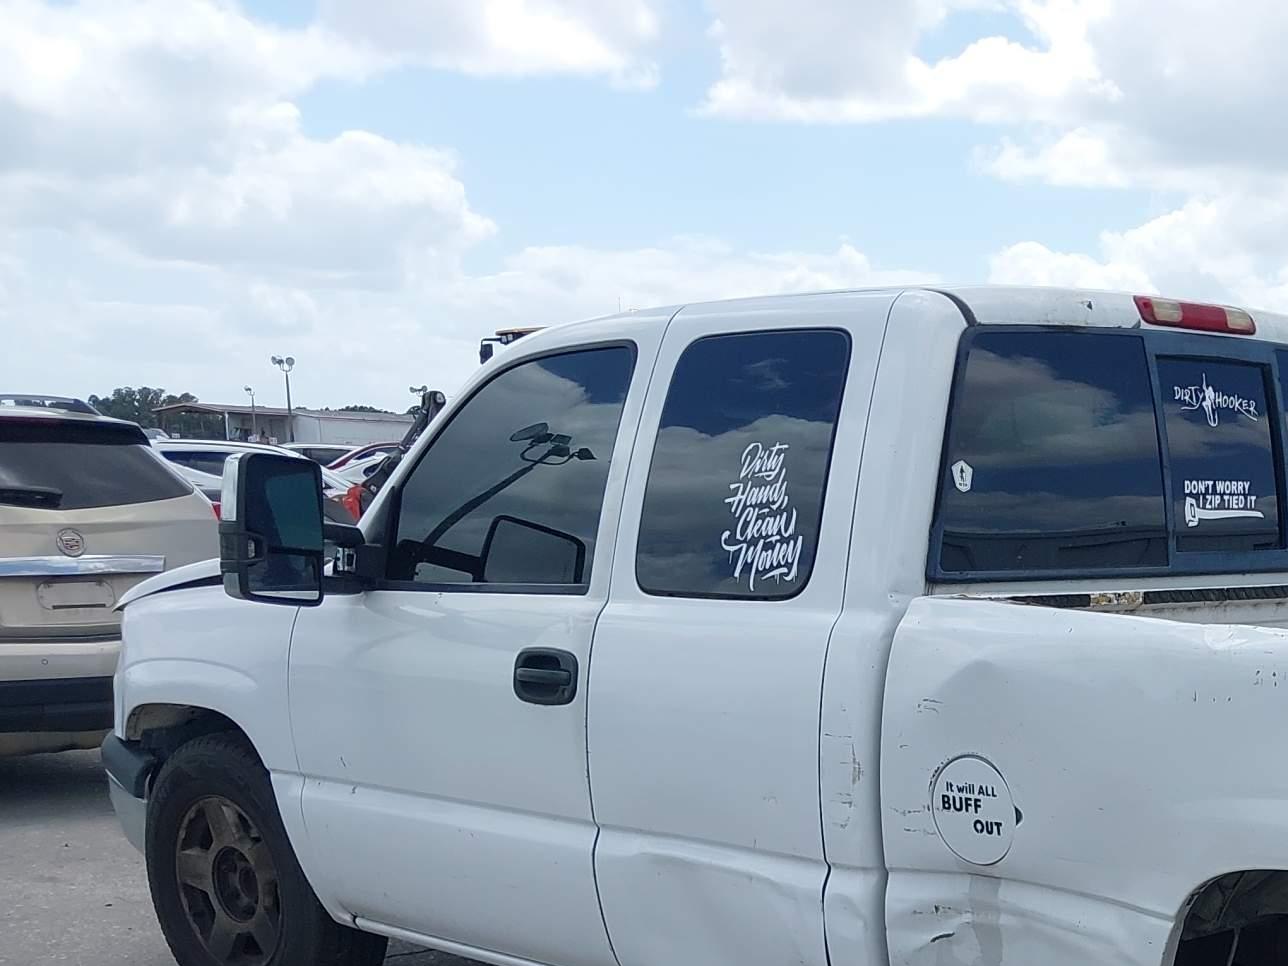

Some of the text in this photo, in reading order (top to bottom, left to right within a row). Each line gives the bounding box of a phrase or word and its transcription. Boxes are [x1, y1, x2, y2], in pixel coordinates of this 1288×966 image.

[1173, 386, 1259, 421] DIRTY HOOKER
[739, 442, 789, 480] Dirty
[1184, 480, 1251, 494] DON'T WORRY
[1199, 496, 1257, 509] I ZIP TIED IT
[735, 506, 797, 542] Clean
[721, 530, 803, 591] Money
[945, 781, 998, 797] It will ALL
[941, 794, 982, 814] BUFF
[973, 819, 1003, 836] OUT
